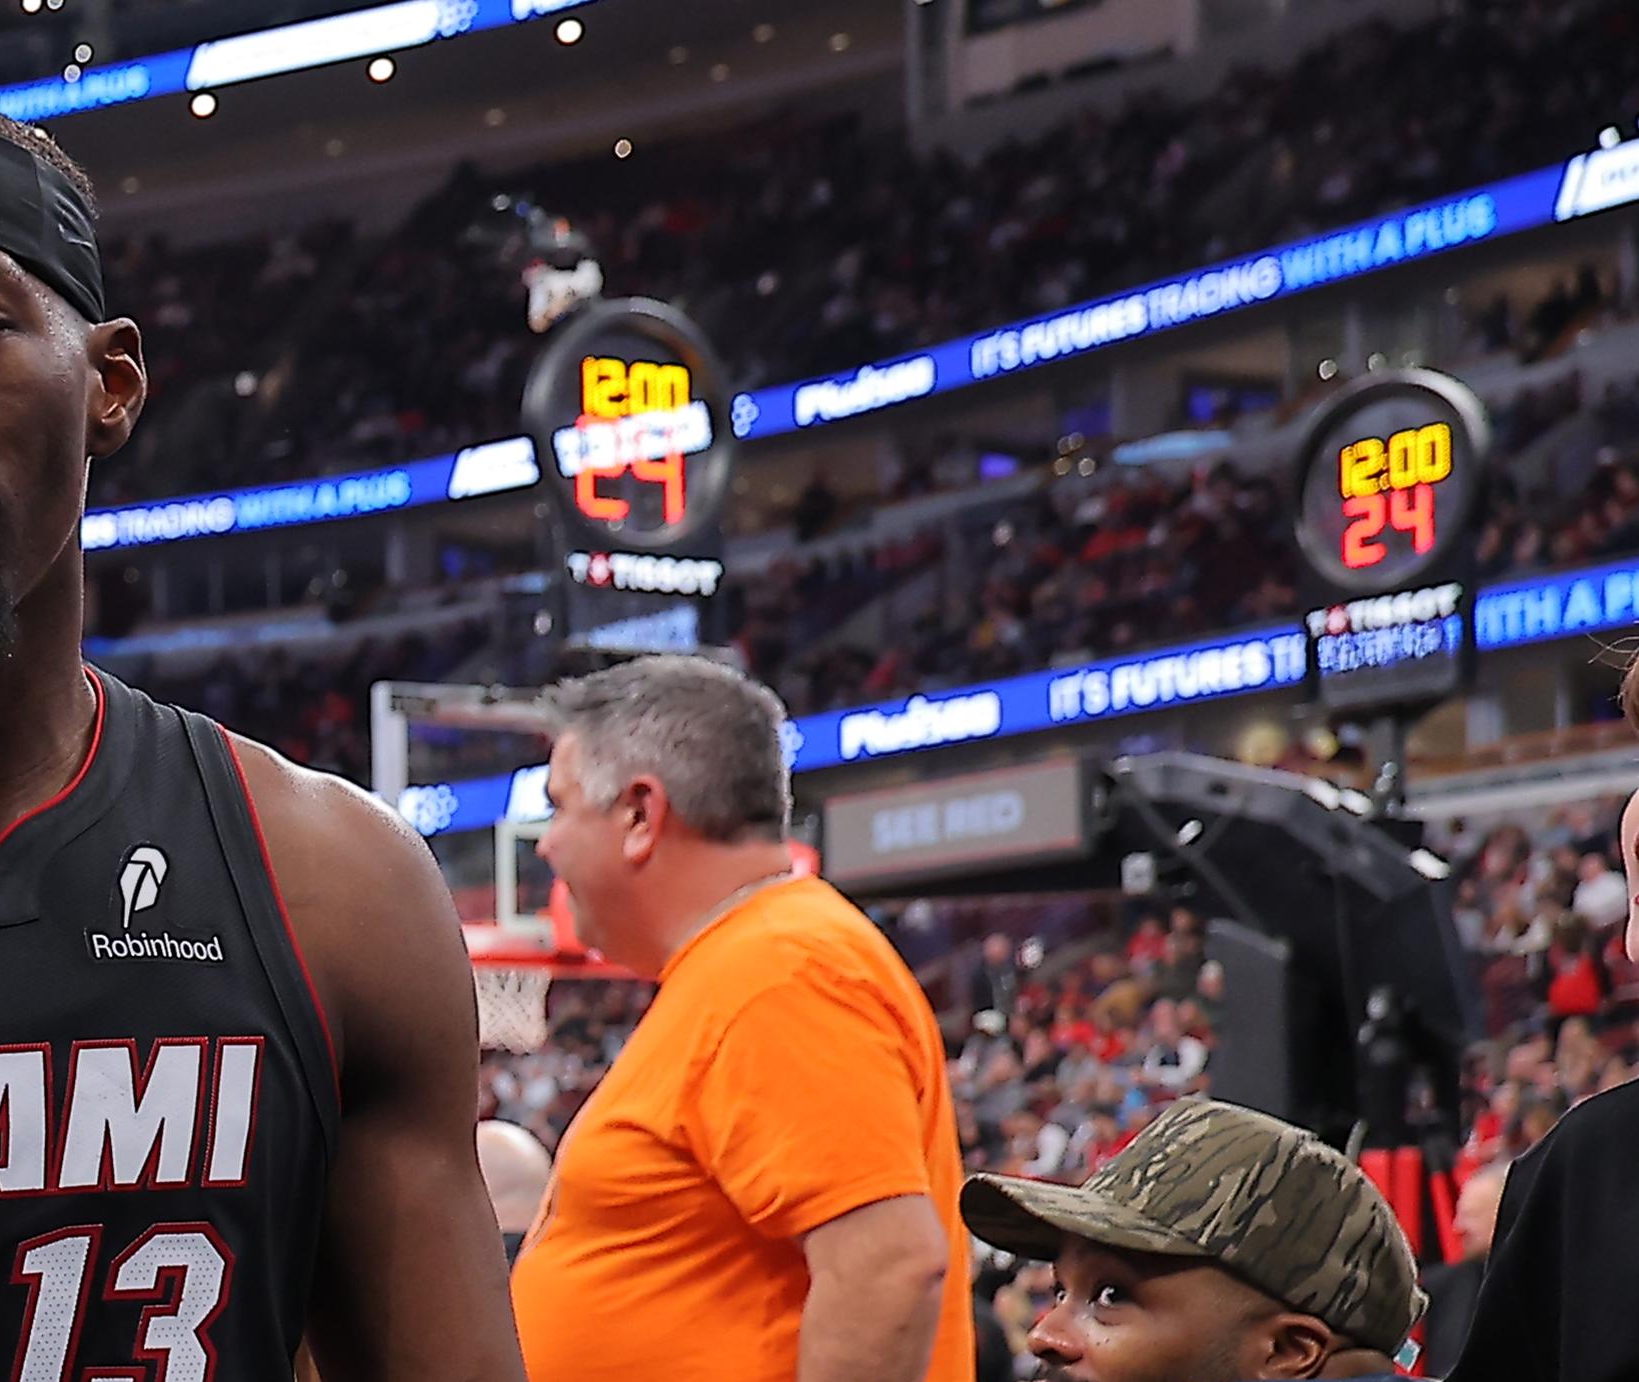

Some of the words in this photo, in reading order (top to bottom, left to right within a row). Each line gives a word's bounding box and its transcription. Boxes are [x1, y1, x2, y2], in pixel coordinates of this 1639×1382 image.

[1021, 294, 1149, 366] FUTURES
[1149, 254, 1283, 331] TRADING
[1283, 222, 1371, 292] WITH
[1405, 191, 1498, 255] PLUS
[1338, 421, 1453, 499] 12:00
[1341, 483, 1437, 570] 24
[1048, 670, 1111, 724] IT'S
[1111, 638, 1271, 709] FUTURES
[92, 932, 224, 964] Robinhood
